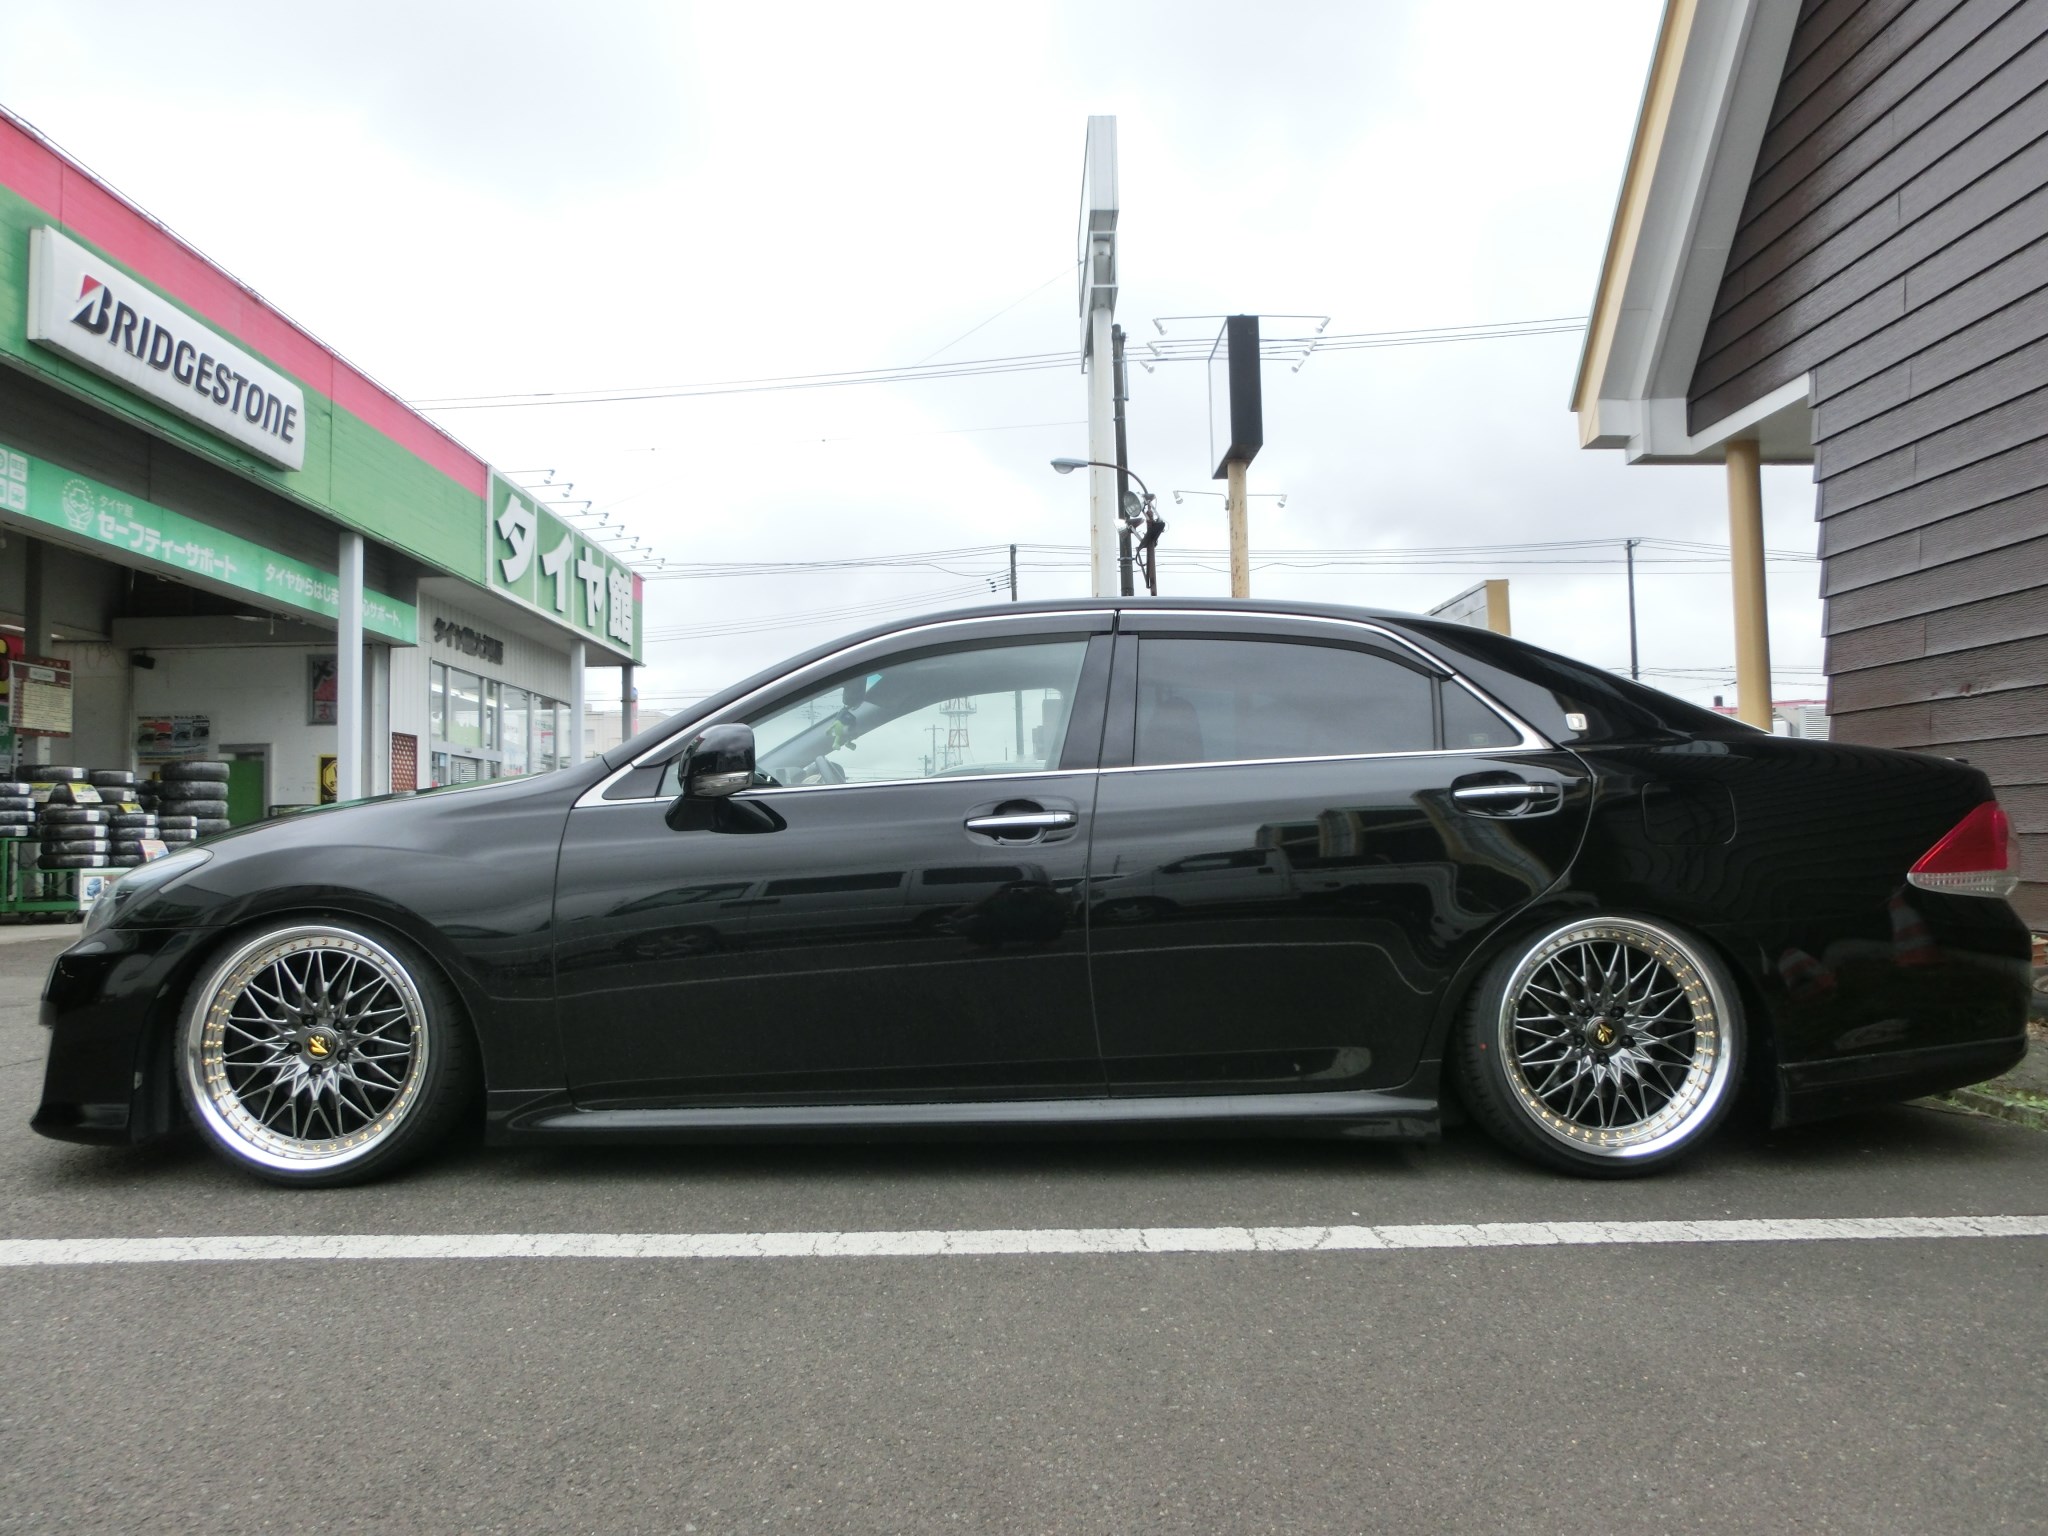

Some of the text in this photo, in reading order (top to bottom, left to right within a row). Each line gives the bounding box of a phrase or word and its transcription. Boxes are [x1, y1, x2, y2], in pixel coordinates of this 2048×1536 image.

[70, 273, 298, 444] BRIDGESTONE
[97, 510, 238, 579] セーフティーサポート
[494, 493, 632, 647] タイヤ館
